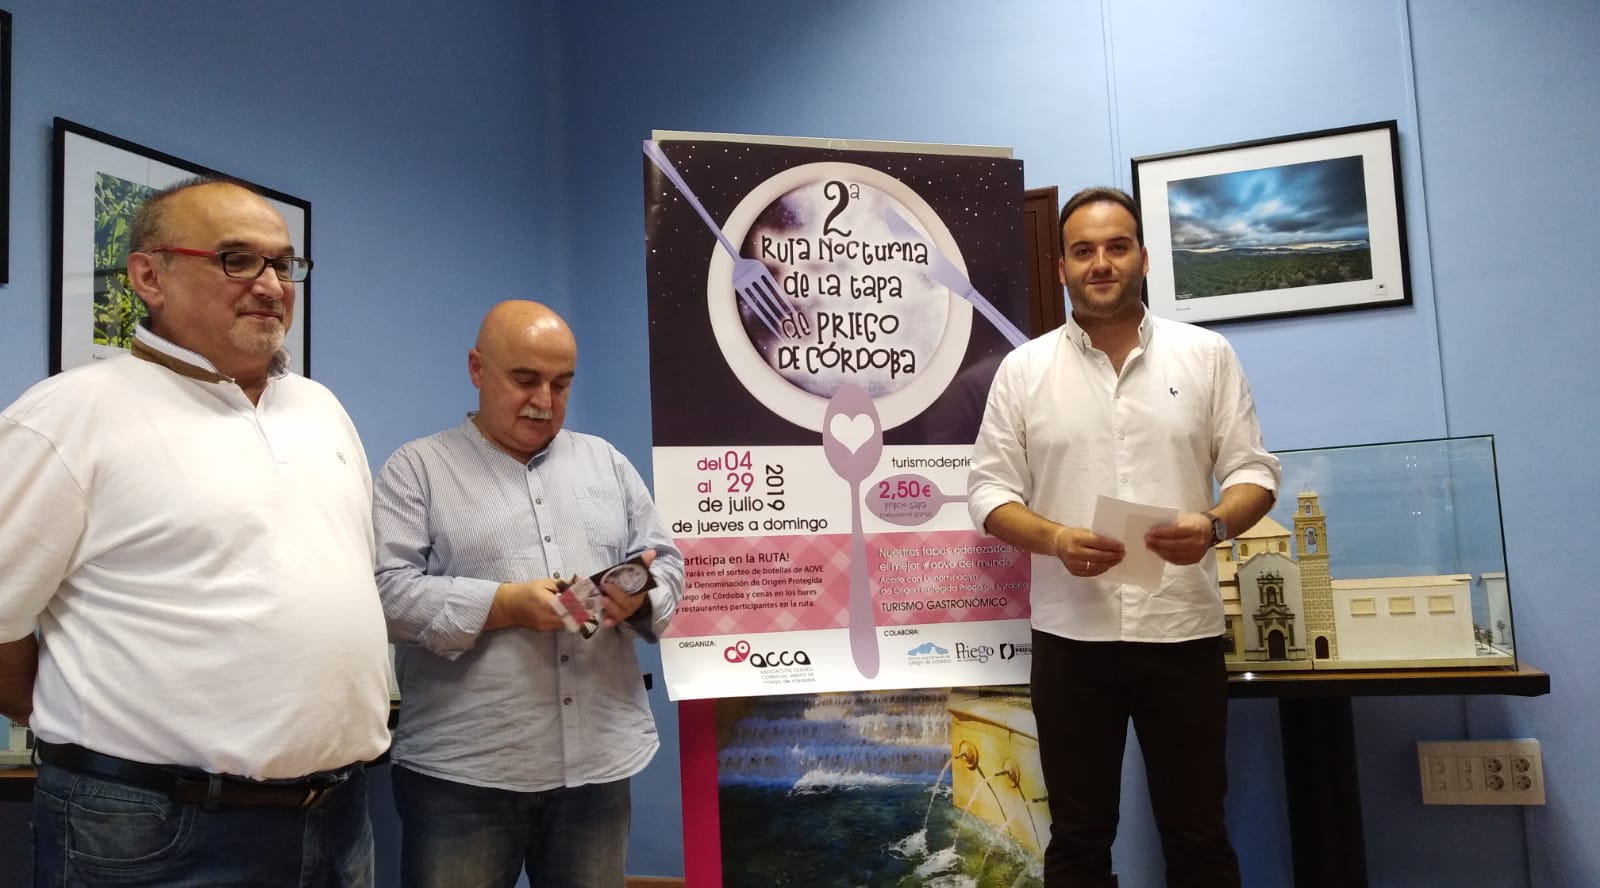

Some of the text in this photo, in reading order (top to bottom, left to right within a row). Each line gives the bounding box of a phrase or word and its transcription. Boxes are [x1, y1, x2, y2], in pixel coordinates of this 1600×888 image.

[783, 272, 809, 298] de
[697, 450, 753, 471] del 04
[891, 456, 972, 469] turismodeprie
[697, 472, 754, 493] al 29
[766, 464, 785, 511] 2019
[879, 480, 932, 500] 2,50€
[698, 496, 764, 515] de julio
[672, 517, 828, 535] de jueves a domingo
[684, 552, 790, 567] articipa en la RUTA!
[879, 561, 889, 571] el
[891, 561, 919, 573] mejor
[959, 559, 975, 569] del
[976, 557, 1013, 568] mundo
[685, 568, 705, 578] rarás
[717, 567, 725, 576] el
[726, 567, 751, 576] sorteo
[751, 567, 761, 575] de
[762, 566, 791, 575] botellas
[793, 566, 803, 574] de
[685, 576, 823, 589] la Denominación de Origen Protegida
[682, 588, 817, 603] iego de Córdoba y cenas en los bares
[681, 604, 728, 613] restaurantes
[729, 602, 778, 612] participantes
[790, 600, 798, 608] la
[798, 600, 816, 608] ruta.
[881, 596, 1008, 612] TURISMO GASTRONÓMICO
